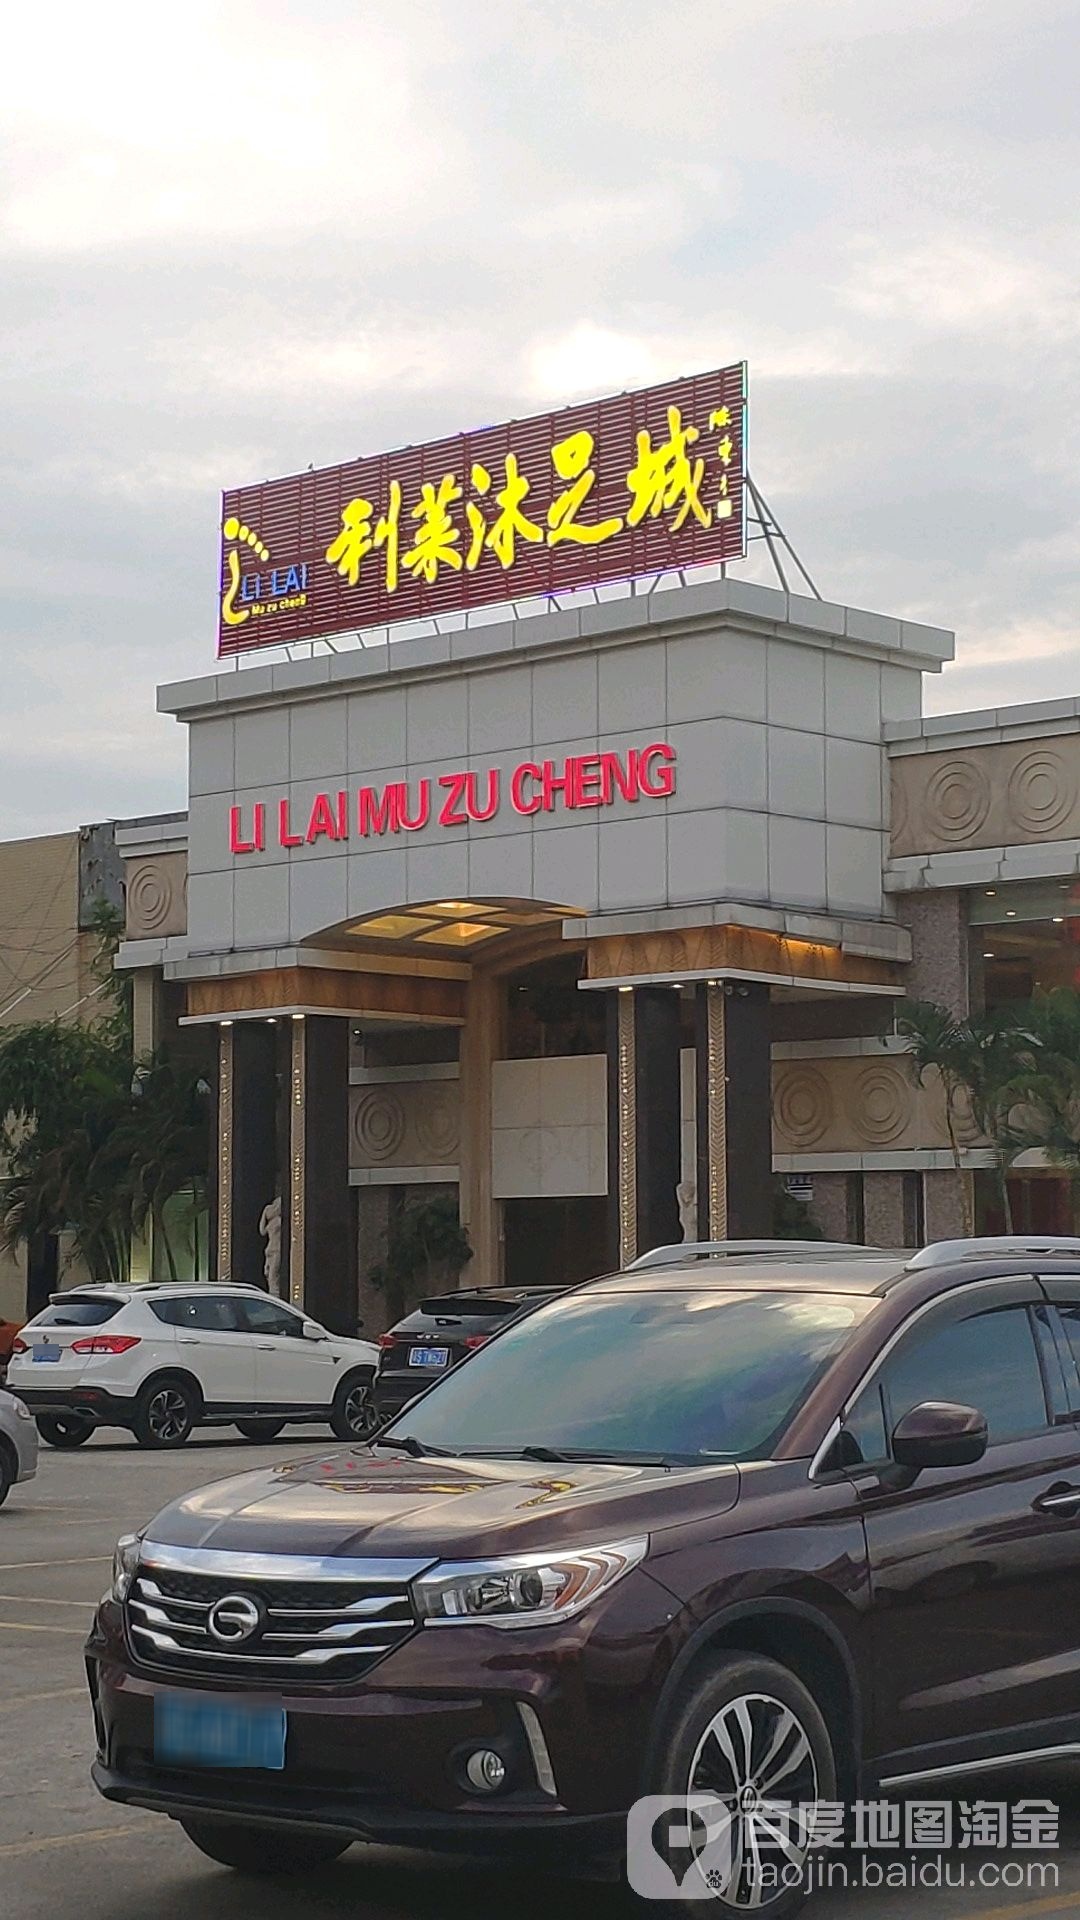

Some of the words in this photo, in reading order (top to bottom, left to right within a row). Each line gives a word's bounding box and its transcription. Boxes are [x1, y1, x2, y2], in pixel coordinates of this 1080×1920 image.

[326, 405, 712, 593] 利莱沐足城
[241, 572, 262, 601] LI
[271, 562, 308, 595] LAI
[229, 801, 266, 853] LI
[279, 791, 348, 847] LAI
[357, 778, 431, 838] MU
[438, 768, 500, 827] ZU
[511, 743, 677, 815] CHENG
